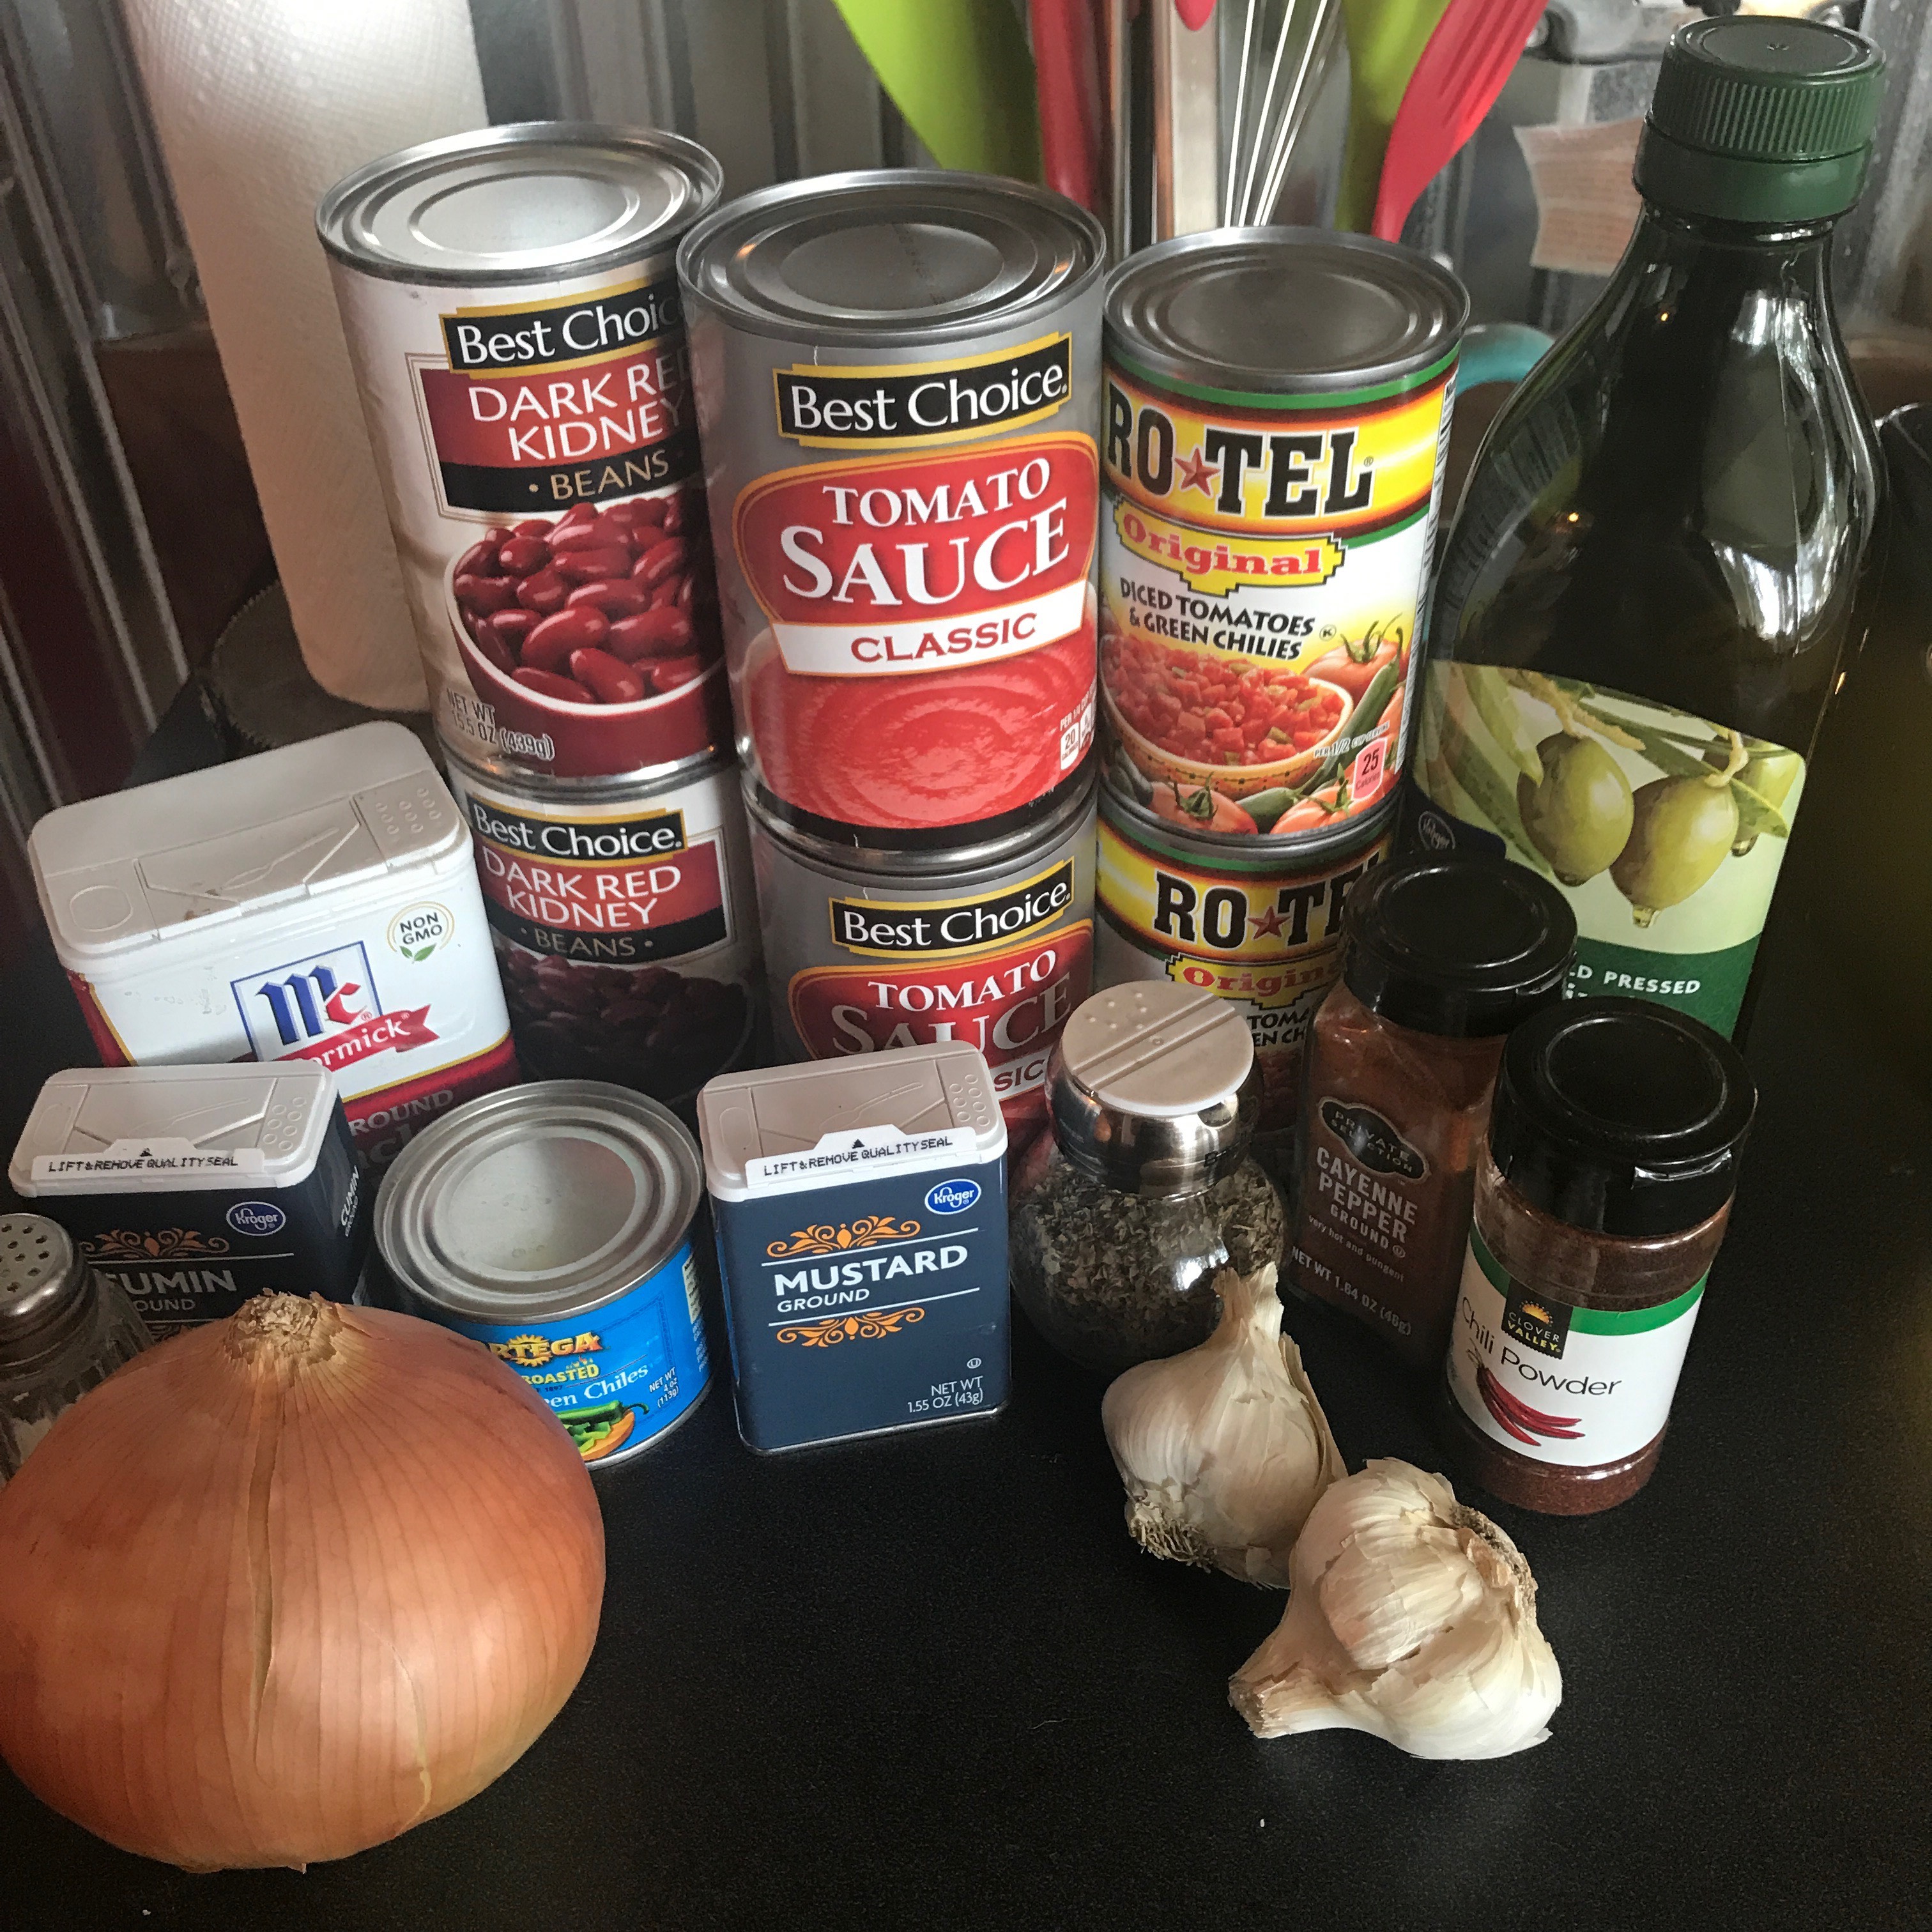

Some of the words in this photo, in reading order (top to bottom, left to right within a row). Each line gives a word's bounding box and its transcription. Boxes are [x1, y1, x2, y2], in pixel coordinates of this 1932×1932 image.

[456, 320, 556, 364] Best
[562, 293, 678, 351] Choic
[468, 372, 618, 423] DARK
[791, 385, 898, 432] Best
[508, 387, 685, 462] KIDNEY
[549, 449, 670, 500] BEANS
[822, 457, 1051, 527] TOMATO
[780, 498, 1070, 606] SAUCE
[1122, 512, 1322, 576] Original
[1119, 577, 1173, 610] DICED
[1176, 594, 1315, 638] TOMATOES
[850, 612, 1037, 663] CLASSIC
[1129, 607, 1140, 629] &
[1144, 610, 1209, 647] GREEN
[1213, 629, 1302, 661] CHILIES
[447, 687, 468, 715] NET
[471, 700, 496, 725] WT
[478, 722, 497, 744] OZ
[1065, 728, 1075, 751] 20
[1361, 747, 1379, 776] 25
[473, 802, 537, 852] Best
[482, 845, 586, 900] DARK
[595, 865, 682, 900] RED
[399, 912, 439, 934] NON
[505, 884, 658, 928] KIDNEY
[402, 924, 443, 946] GMO
[534, 928, 636, 958] BEANS
[843, 910, 931, 946] Best
[868, 949, 1057, 1012] TOMATO
[1604, 970, 1701, 994] PRESSED
[313, 1017, 411, 1066] ormick
[348, 1089, 454, 1137] ROUND
[1331, 1119, 1413, 1173] SELCTION
[763, 1160, 798, 1177] LIFT
[1316, 1146, 1418, 1225] CAYENNE
[933, 1186, 976, 1208] Kroger
[1319, 1172, 1407, 1244] PEPPER
[234, 1208, 279, 1230] Kroger
[1330, 1204, 1390, 1250] GROUND
[1308, 1215, 1327, 1234] very
[1329, 1227, 1344, 1245] hot
[1346, 1239, 1363, 1257] and
[1366, 1253, 1405, 1283] pungent
[114, 1269, 238, 1295] UMIN
[774, 1245, 969, 1297] MUSTARD
[1292, 1246, 1312, 1269] NET
[1314, 1264, 1331, 1282] WT
[1361, 1294, 1377, 1313] OZ
[136, 1298, 196, 1312] OUND
[777, 1288, 870, 1313] GROUND
[489, 1332, 603, 1359] RTEGA
[1462, 1296, 1496, 1355] Chili
[1500, 1346, 1622, 1396] Powder
[1506, 1322, 1559, 1353] VALLEY
[1508, 1312, 1560, 1343] CLOVER
[545, 1384, 563, 1393] 1897
[584, 1363, 648, 1400] Chiles
[649, 1376, 663, 1393] NET
[664, 1367, 675, 1381] WT
[657, 1385, 679, 1408] (113g)
[664, 1383, 668, 1392] 4
[907, 1397, 930, 1413] 1.55
[932, 1394, 953, 1409] OZ
[954, 1388, 984, 1406] (43g)
[931, 1381, 957, 1397] NET
[960, 1376, 983, 1391] WT
